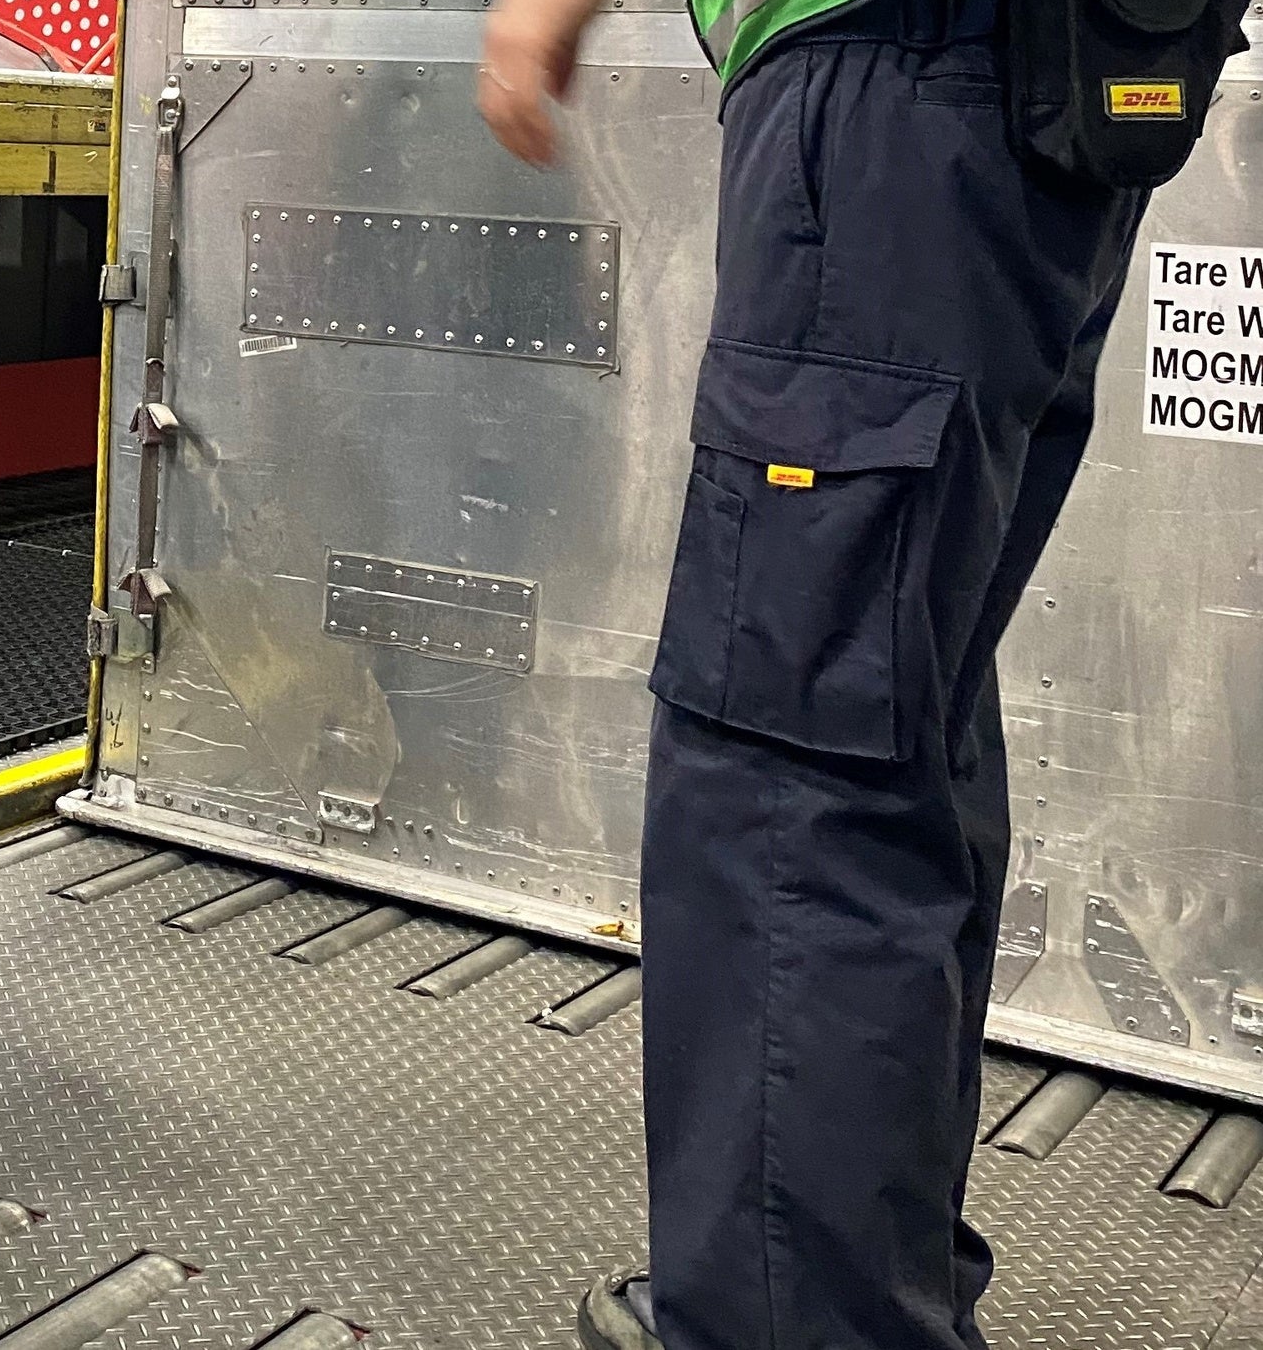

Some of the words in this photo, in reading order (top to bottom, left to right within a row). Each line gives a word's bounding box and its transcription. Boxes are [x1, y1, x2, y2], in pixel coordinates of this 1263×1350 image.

[1122, 92, 1172, 107] DHL
[1155, 251, 1228, 288] Tare
[1153, 299, 1226, 336] Tare
